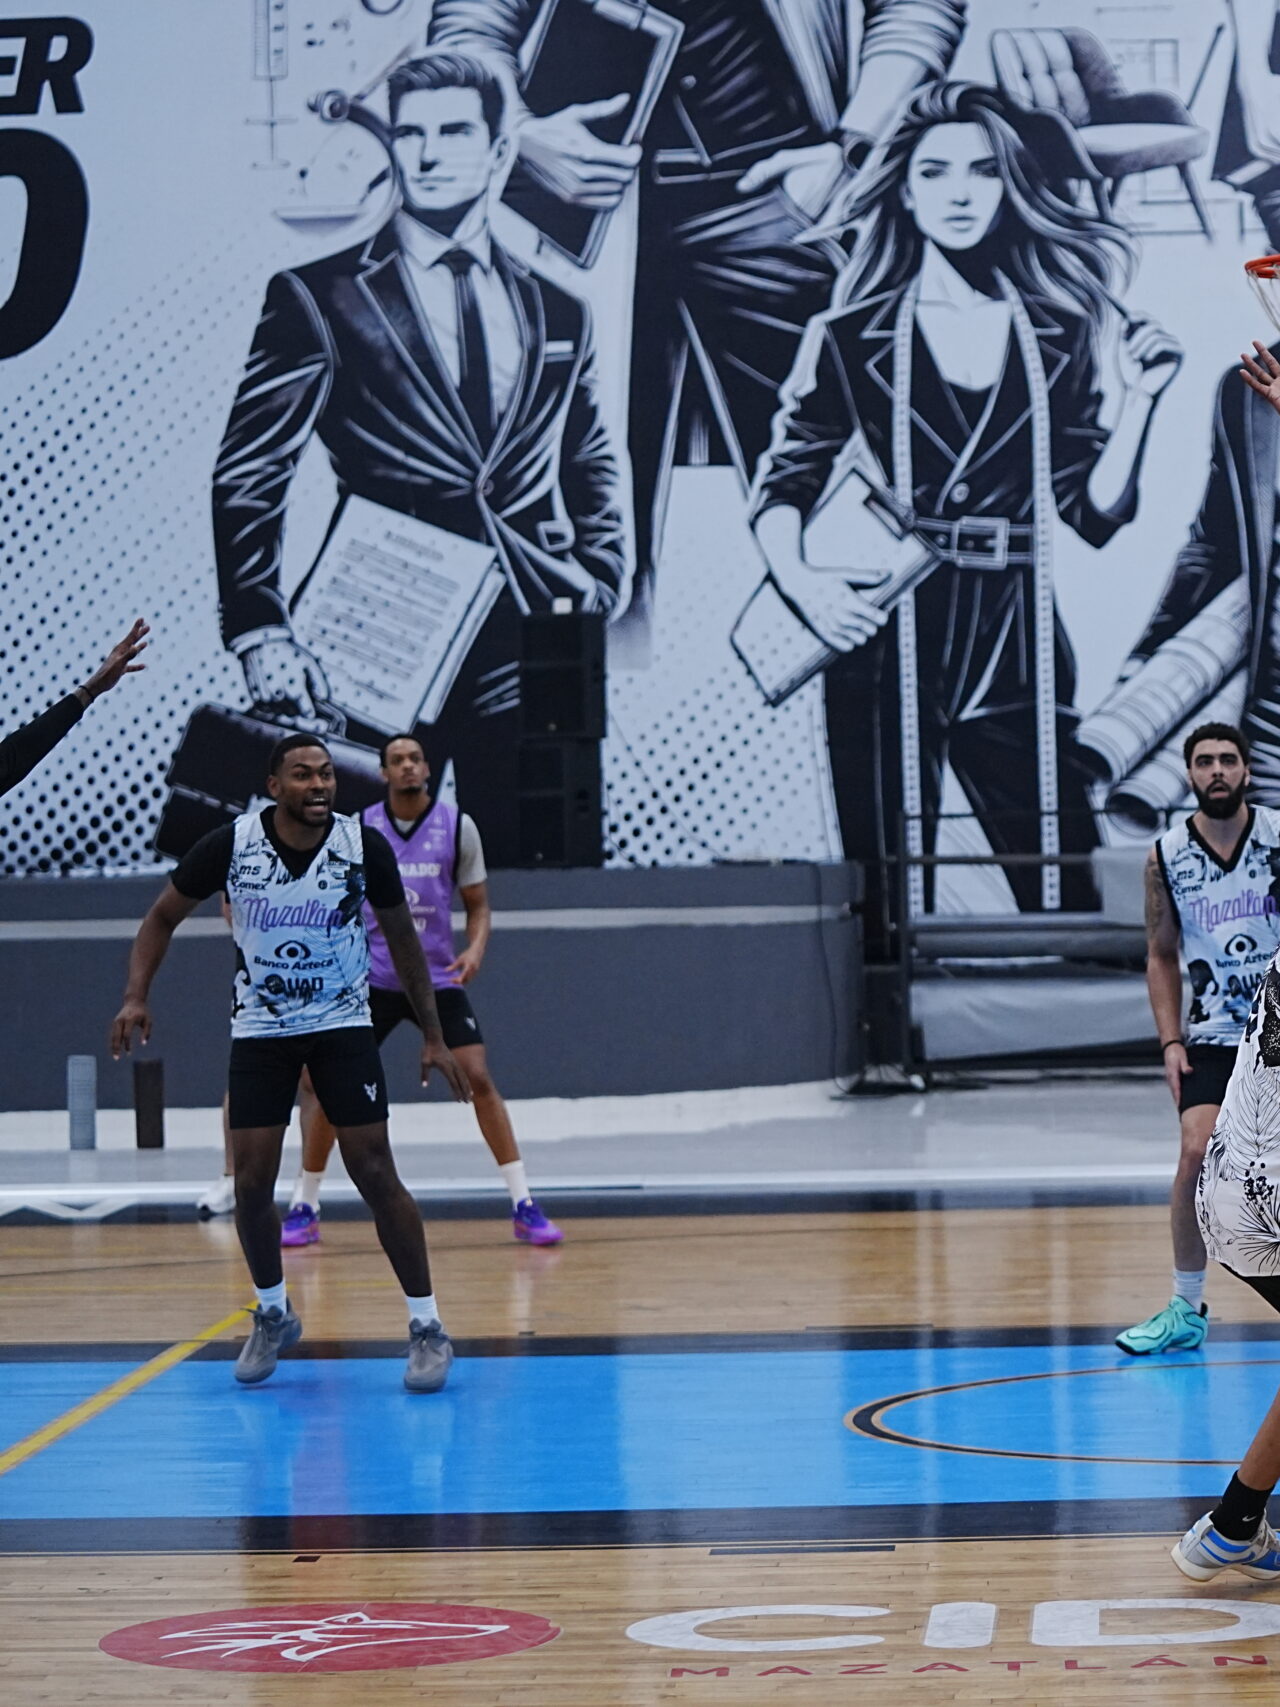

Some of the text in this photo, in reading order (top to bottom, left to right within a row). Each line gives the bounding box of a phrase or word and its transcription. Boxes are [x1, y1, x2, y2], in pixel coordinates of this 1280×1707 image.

[253, 955, 334, 971] Banco Azteca
[1243, 952, 1276, 966] Azte
[670, 1654, 1269, 1679] MAZATLÁN
